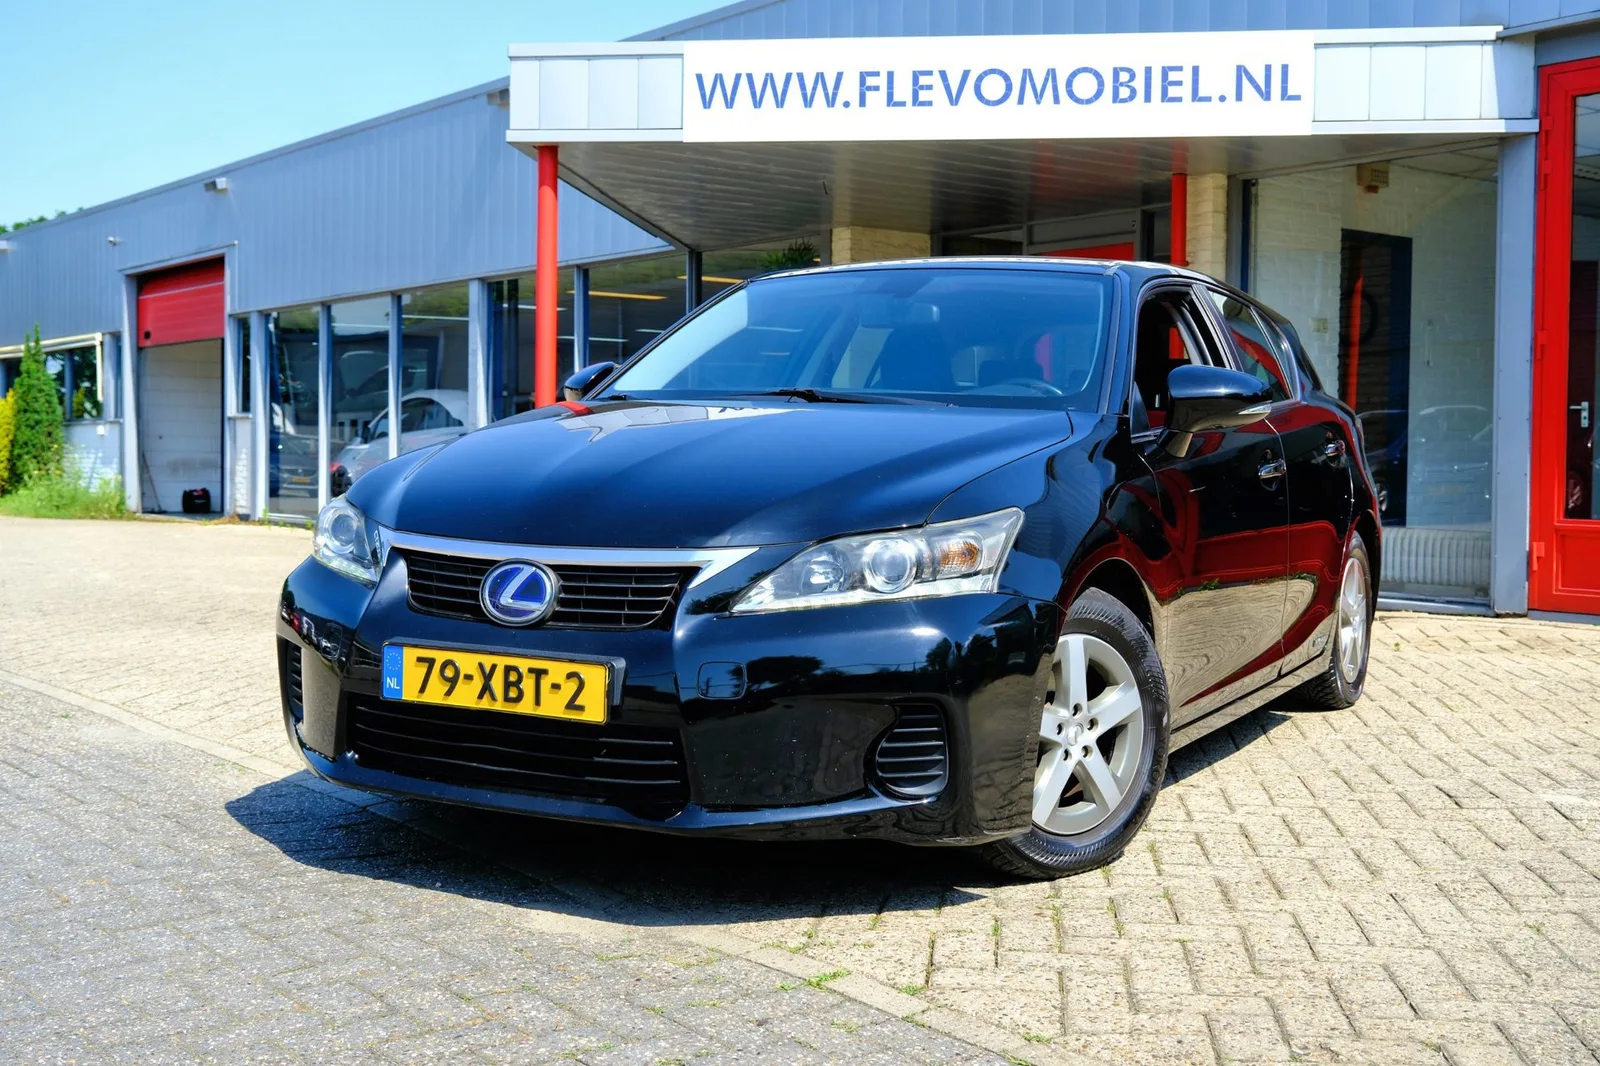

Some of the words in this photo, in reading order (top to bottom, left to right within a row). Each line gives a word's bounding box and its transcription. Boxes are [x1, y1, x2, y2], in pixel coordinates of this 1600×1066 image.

[695, 64, 1302, 109] WWW.FLEVOMOBIEL.NL
[386, 676, 401, 690] NL
[416, 656, 586, 712] 79-XBT-2
